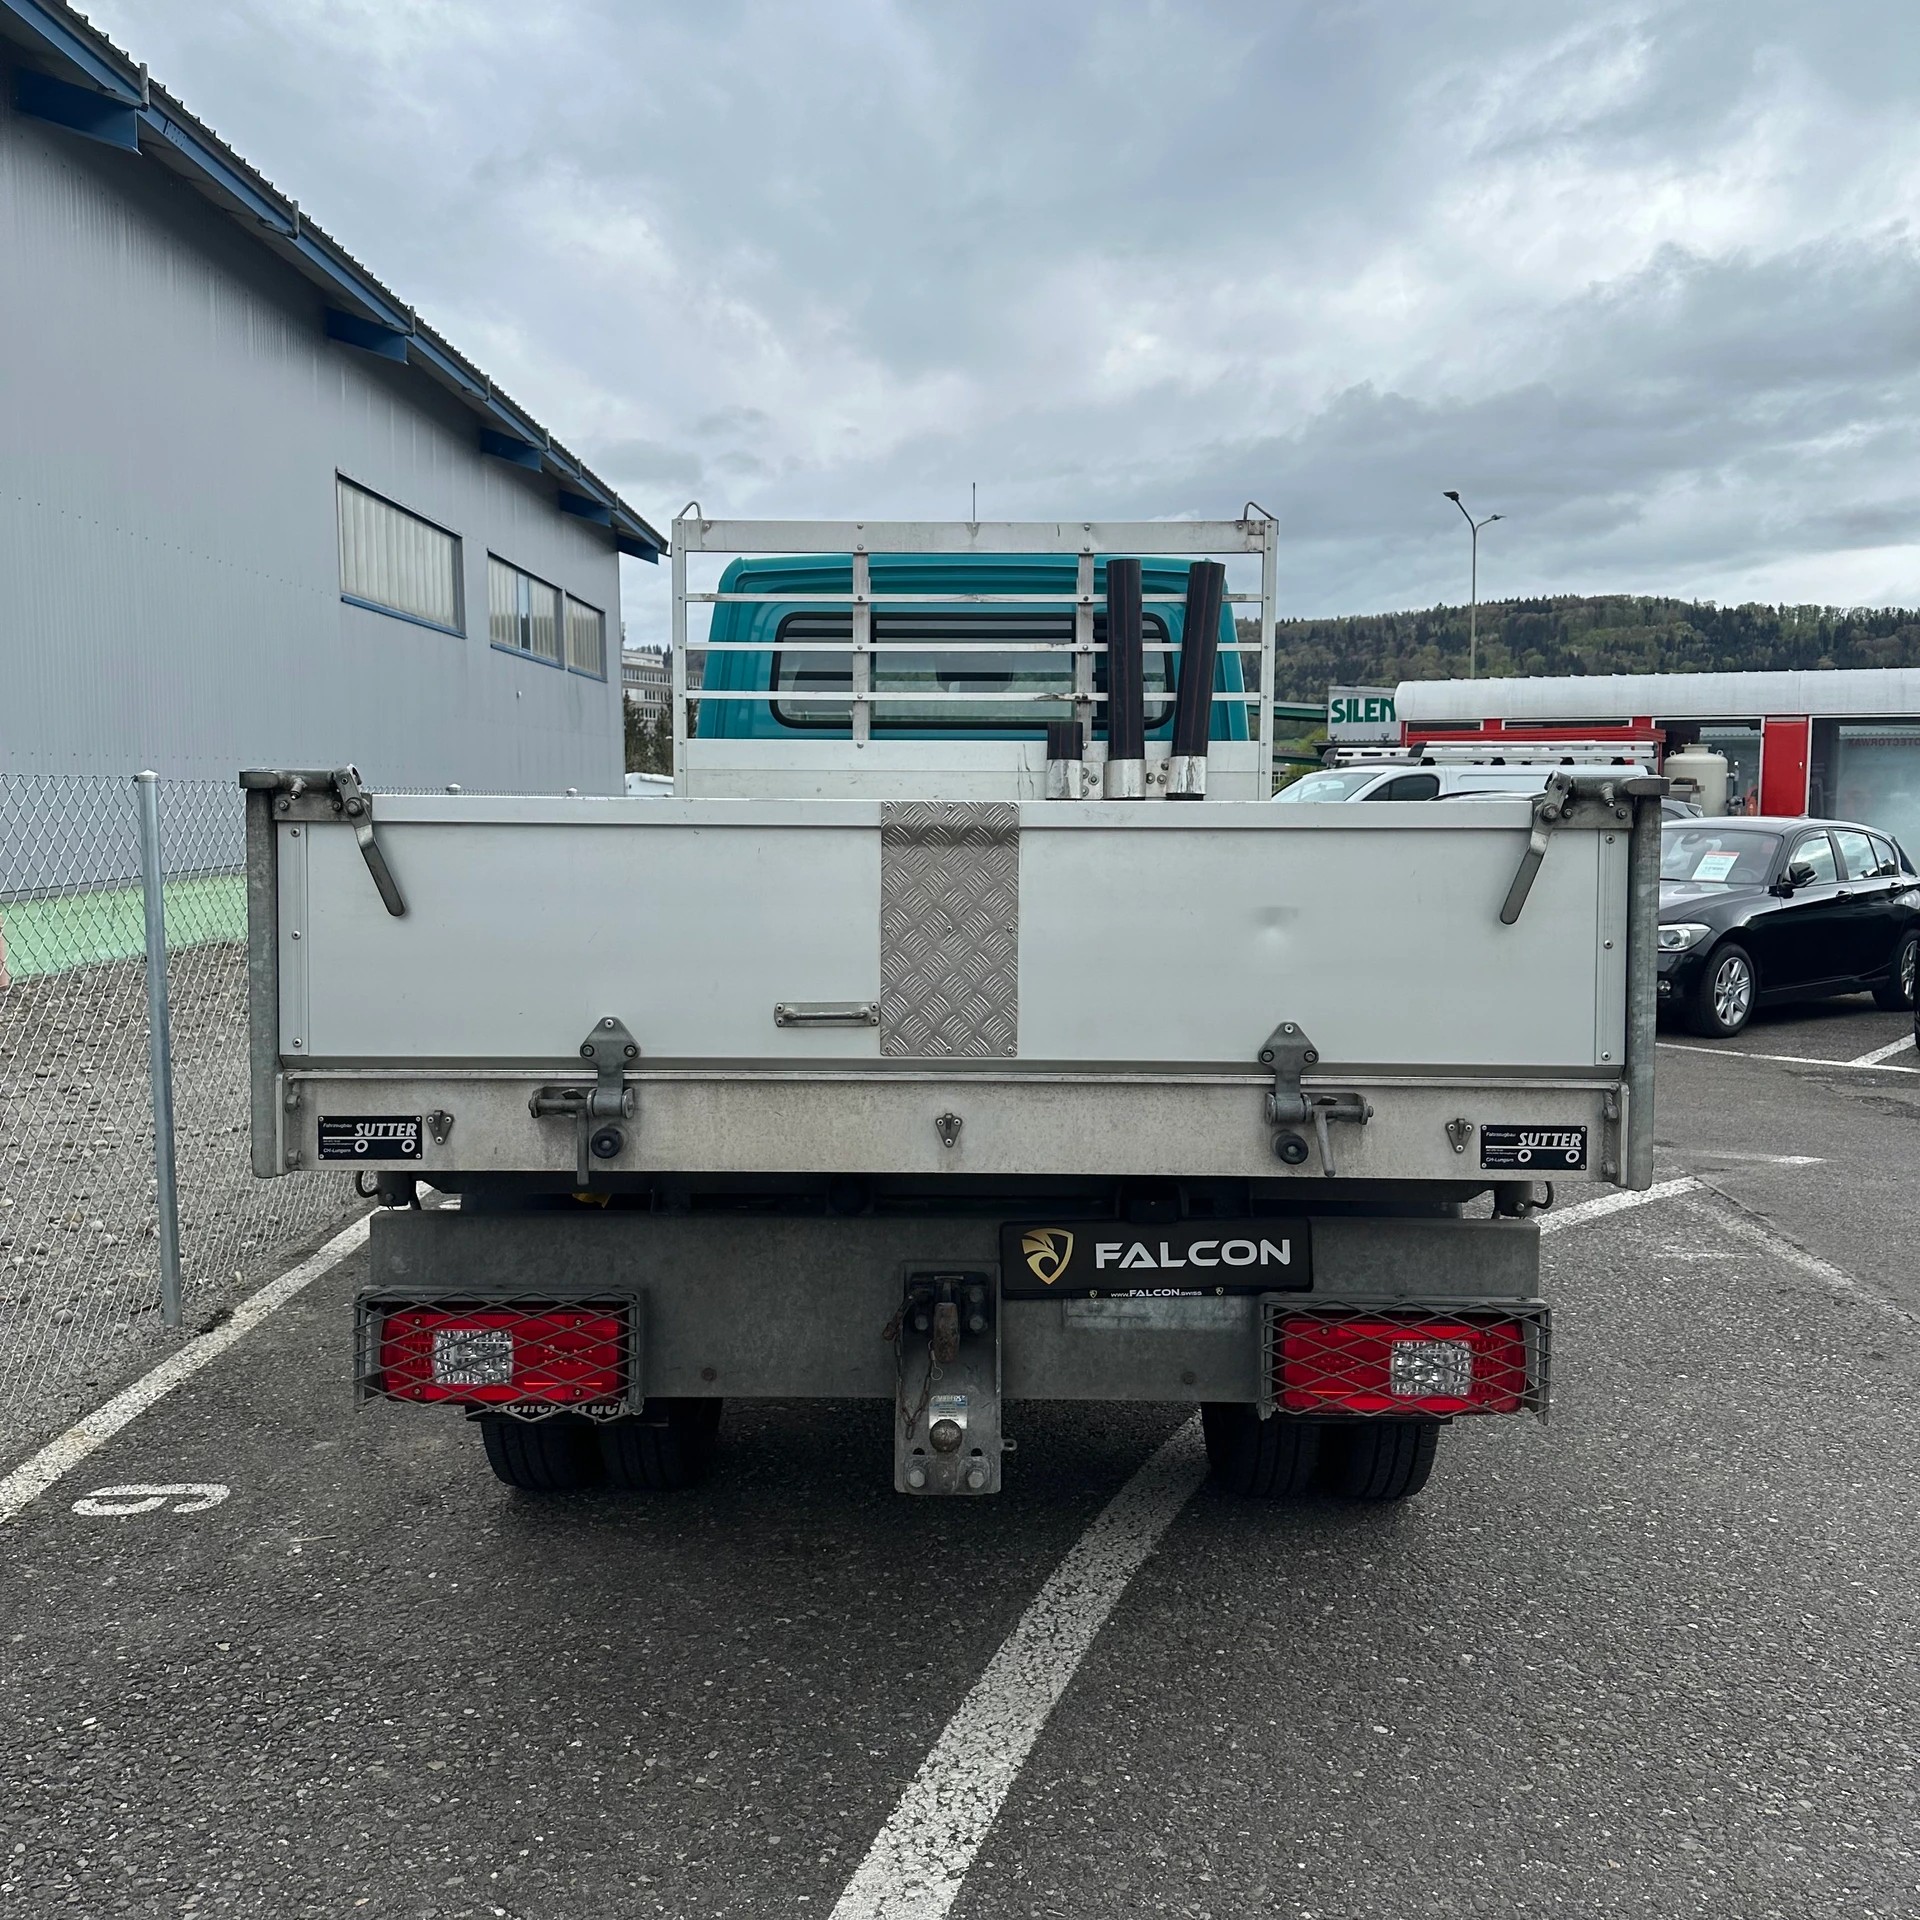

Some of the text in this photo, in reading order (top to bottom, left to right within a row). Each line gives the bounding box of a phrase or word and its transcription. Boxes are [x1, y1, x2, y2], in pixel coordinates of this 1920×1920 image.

[354, 1123, 417, 1137] SUTTER
[1518, 1132, 1582, 1147] SUTTER
[1095, 1239, 1291, 1269] FALCON
